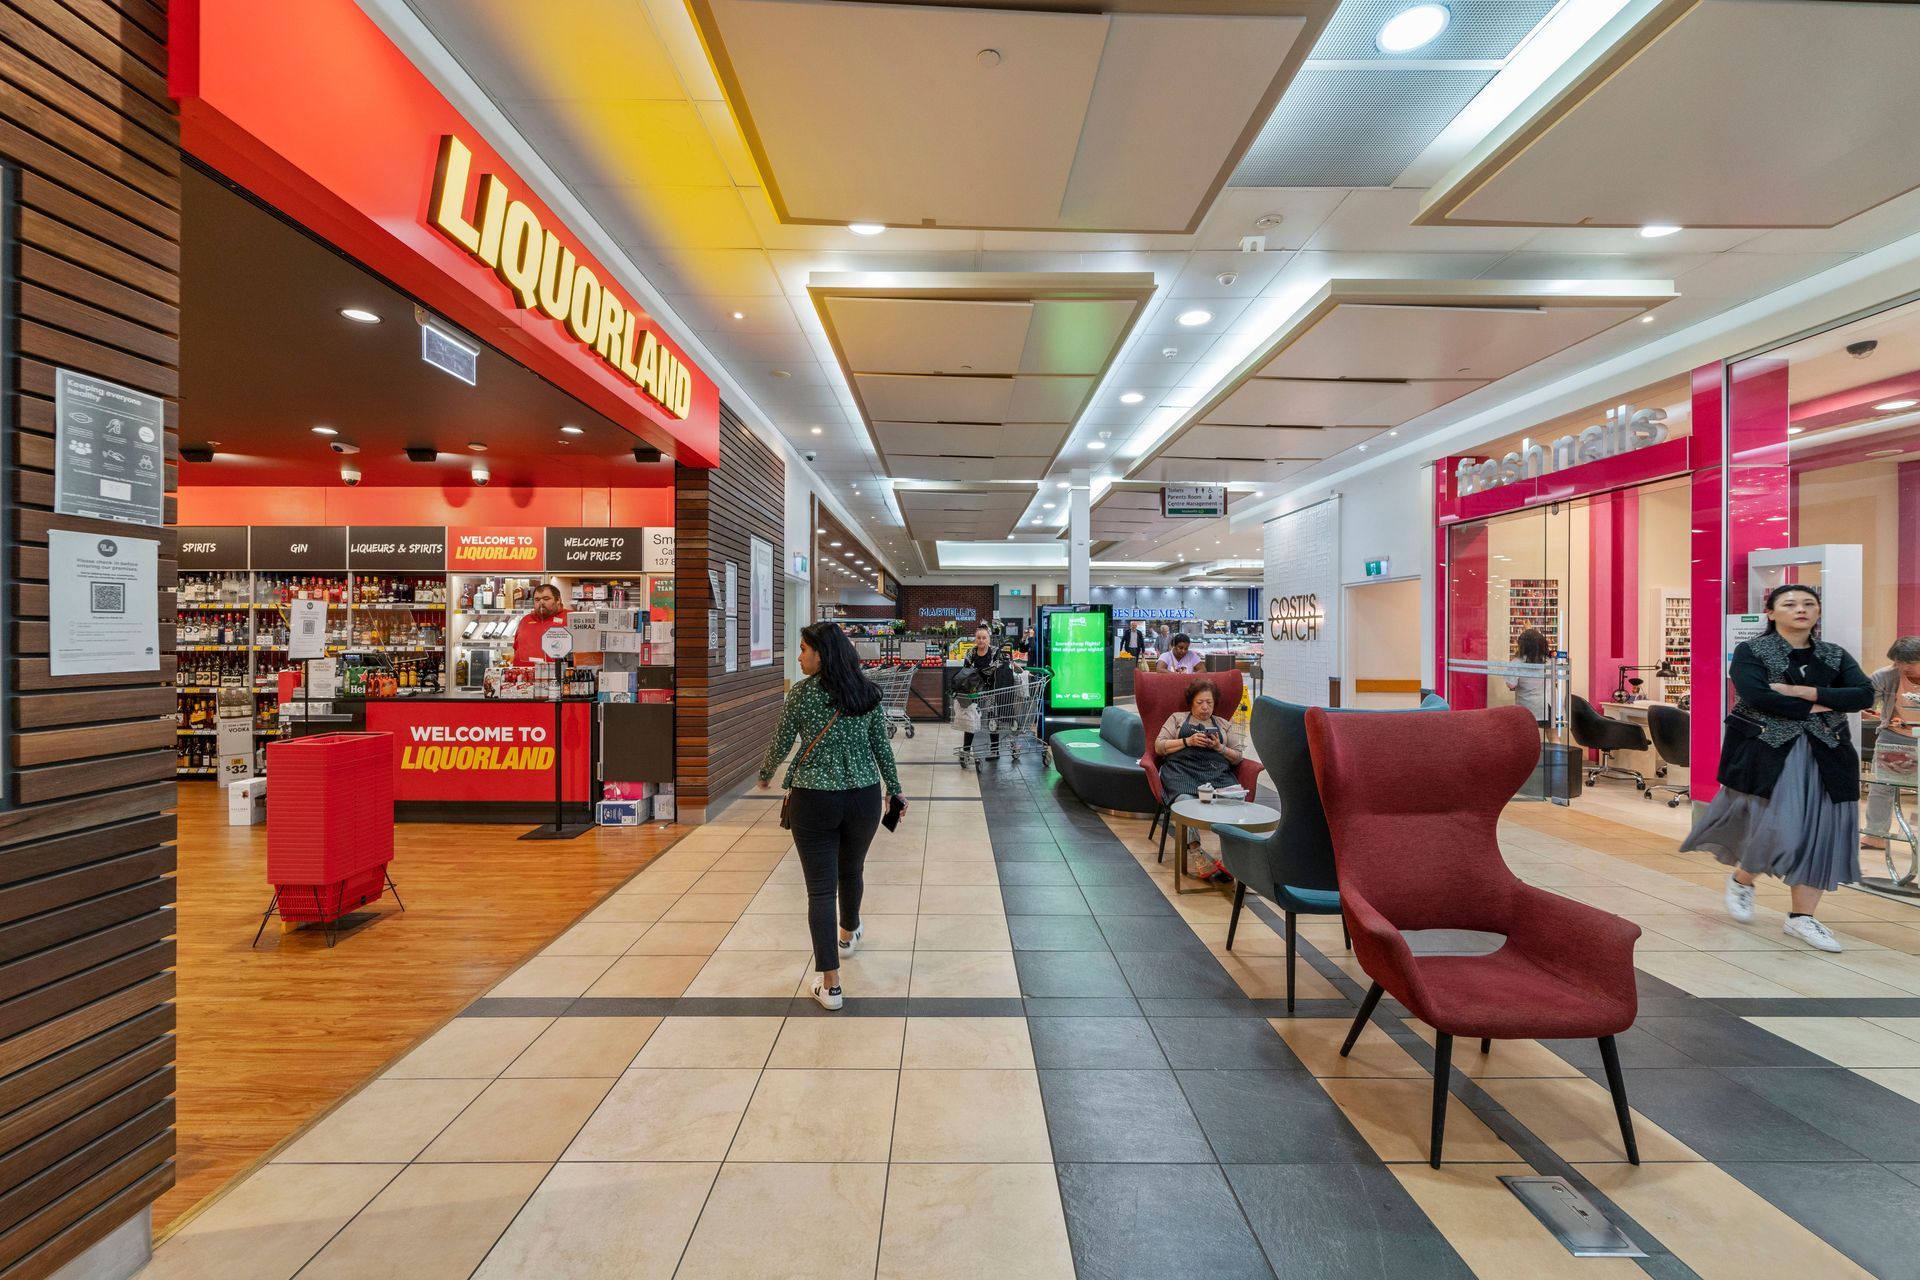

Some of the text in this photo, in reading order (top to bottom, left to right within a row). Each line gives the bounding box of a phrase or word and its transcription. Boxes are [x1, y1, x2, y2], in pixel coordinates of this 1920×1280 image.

[427, 134, 691, 421] LIQUORLAND
[67, 379, 142, 406] Keeping everyone
[67, 387, 101, 402] healthy
[460, 536, 533, 545] WELCOME TO
[564, 537, 624, 547] WELCOME TO
[182, 543, 217, 553] SPIRITS
[290, 543, 308, 553] GIN
[350, 543, 443, 554] LIQUEURS & SPIRITS
[455, 546, 537, 561] LIQUORLAND
[566, 551, 622, 562] LOW PRICES
[655, 558, 669, 566] 137
[1269, 593, 1317, 618] COSTI'S
[1132, 608, 1157, 618] FINE
[1159, 608, 1195, 618] MEATS
[1270, 617, 1317, 641] CATCH
[410, 726, 546, 742] WELCOME TO
[401, 746, 555, 773] LIQUORLAND
[226, 765, 248, 775] $32
